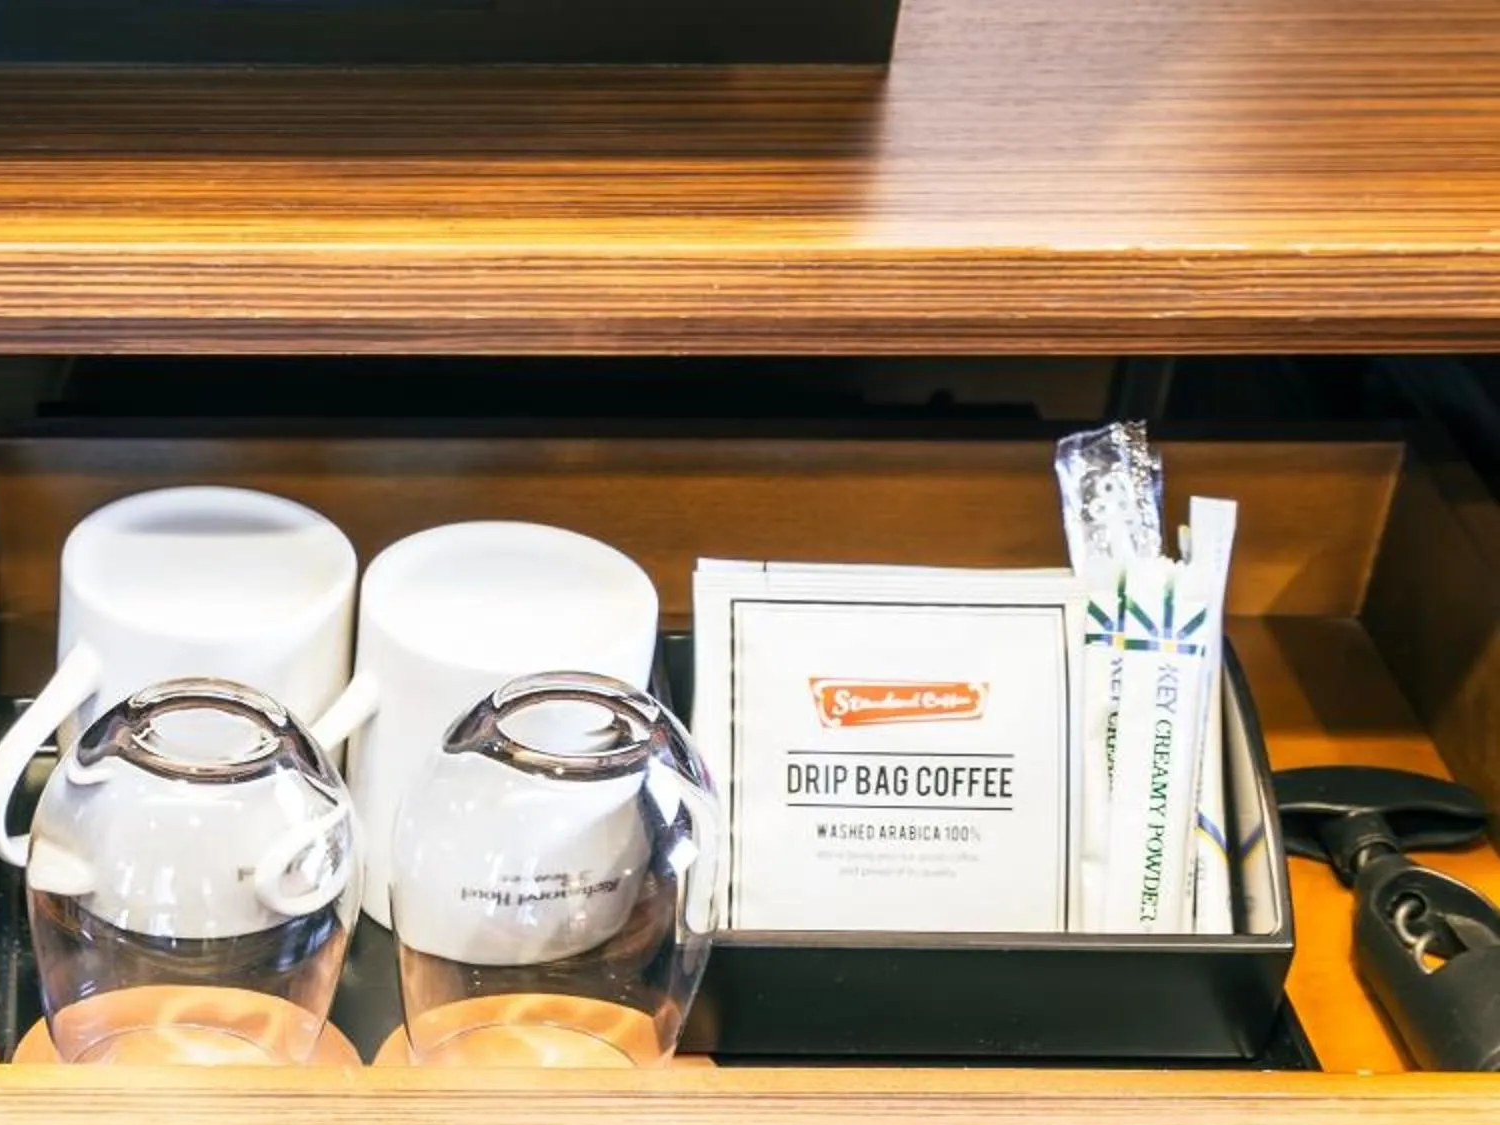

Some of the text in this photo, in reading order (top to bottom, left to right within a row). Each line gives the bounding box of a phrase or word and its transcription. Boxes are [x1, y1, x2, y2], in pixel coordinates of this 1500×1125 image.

[787, 763, 1013, 798] DRIP BAG COFFEE
[1140, 663, 1180, 922] KEY CREAMY POWDER
[817, 824, 981, 842] WASHED ARABICA 100%
